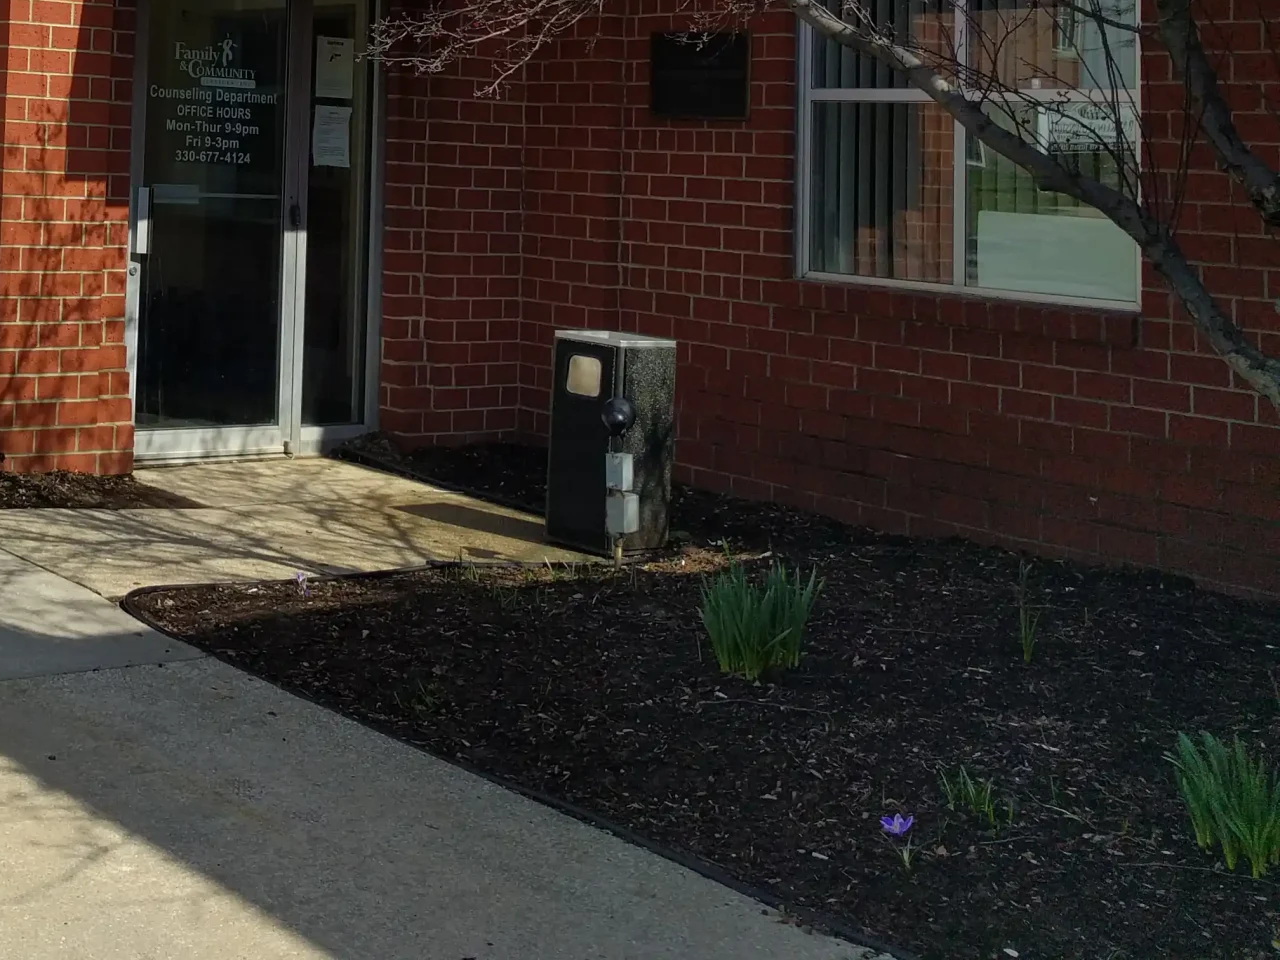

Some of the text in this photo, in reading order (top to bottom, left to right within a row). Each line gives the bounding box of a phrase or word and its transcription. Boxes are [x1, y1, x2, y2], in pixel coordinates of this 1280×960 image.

[174, 41, 220, 66] Family
[150, 84, 278, 105] Counseling Department
[177, 104, 252, 119] OFFICE HOURS
[166, 119, 260, 136] Mon-Thur 9-9pm
[185, 135, 240, 150] Fri 9-3pm
[175, 149, 251, 164] 330-677-4124
